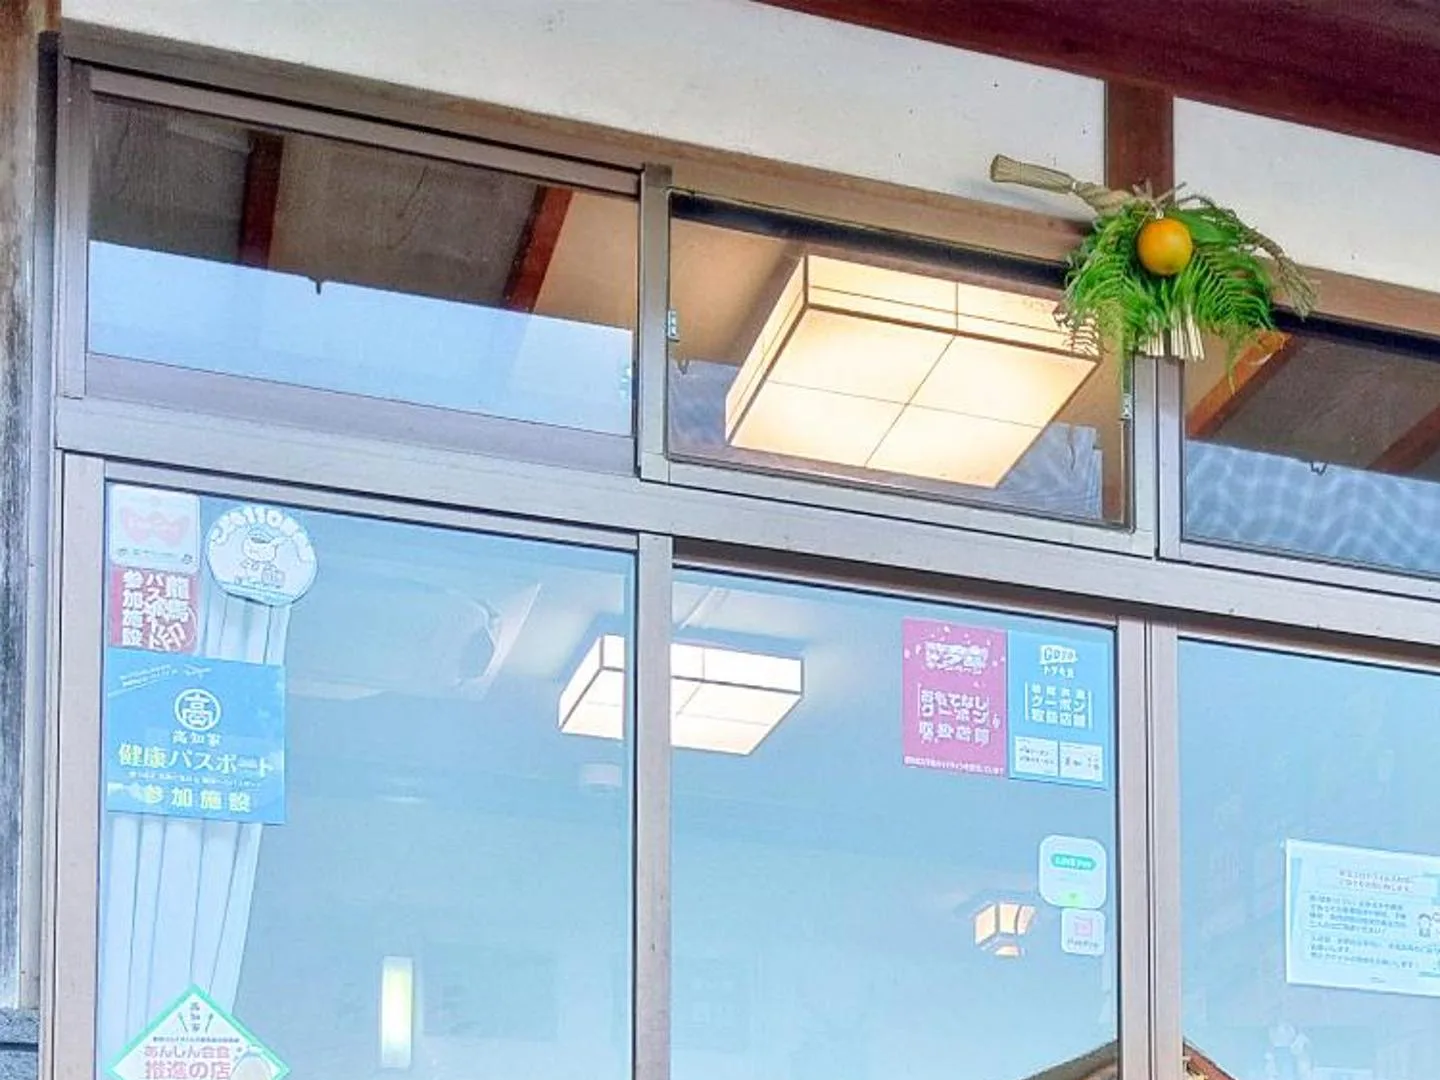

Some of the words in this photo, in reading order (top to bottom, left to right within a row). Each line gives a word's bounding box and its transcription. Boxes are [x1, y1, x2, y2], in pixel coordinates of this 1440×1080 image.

[122, 569, 144, 646] 参加施設
[118, 742, 274, 777] 健康パスポート
[144, 784, 251, 812] 参加施設
[144, 1045, 230, 1059] あんしん会食
[145, 1062, 231, 1080] 推進の店
